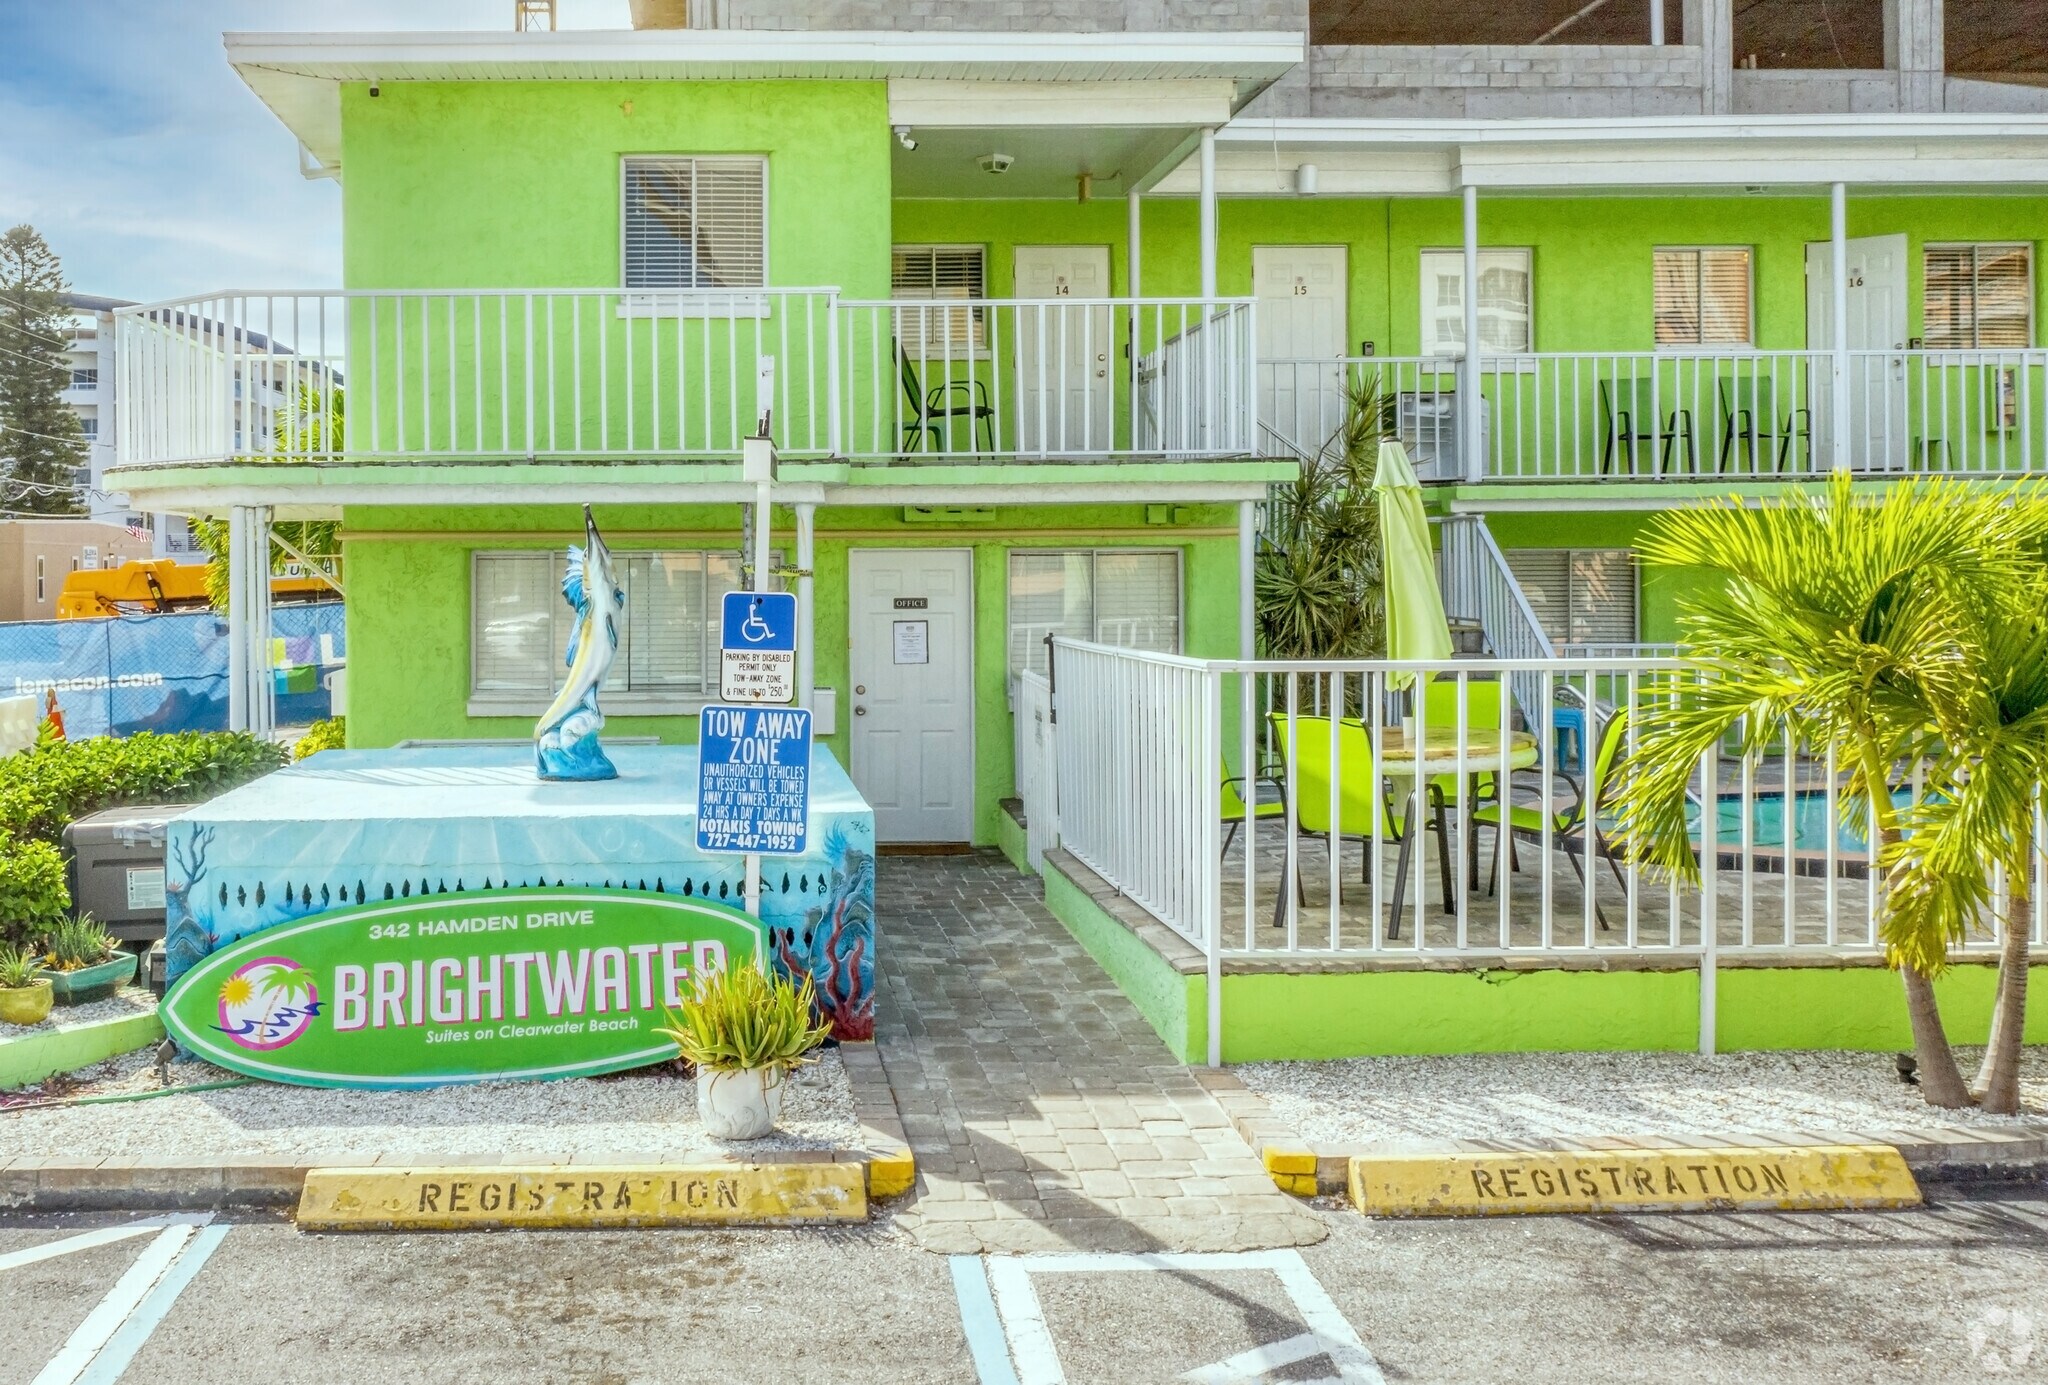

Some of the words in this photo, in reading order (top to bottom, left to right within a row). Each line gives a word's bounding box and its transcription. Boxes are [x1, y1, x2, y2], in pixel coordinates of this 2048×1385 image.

[1056, 286, 1069, 295] 14
[1294, 286, 1307, 295] 15
[1850, 277, 1863, 287] 16
[726, 653, 750, 661] PARKING
[762, 654, 790, 662] DISABLED
[739, 663, 759, 671] PERMIT
[734, 674, 763, 682] TOW-AWAY
[766, 675, 782, 683] ZONE
[726, 688, 730, 696] &
[733, 688, 746, 696] FINE
[707, 710, 746, 737] TOW
[755, 712, 806, 739] AWAY
[729, 737, 780, 765] ZONE
[704, 763, 763, 777] UNAUTHORIZED
[768, 766, 804, 780] VEHICLES
[703, 777, 713, 790] OR
[716, 778, 746, 791] VESSELS
[750, 779, 765, 793] WILL
[769, 780, 777, 793] BE
[781, 780, 804, 794] TOWED
[703, 791, 721, 804] AWAY
[725, 792, 733, 805] AT
[737, 792, 767, 806] OWNERS
[771, 794, 803, 808] EXPENSE
[703, 805, 712, 818] 24
[716, 806, 729, 819] HRS
[733, 806, 738, 819] A
[741, 806, 753, 820] DAY
[756, 807, 760, 820] 7
[763, 808, 780, 821] DAYS
[783, 808, 788, 821] A
[792, 808, 802, 821] WK
[700, 819, 750, 834] KOTAKIS
[757, 821, 804, 836] TOWING
[707, 833, 796, 850] 727-447-1952
[369, 923, 410, 939] 342
[418, 915, 518, 936] HAMDEN
[526, 910, 594, 929] DRIVE
[333, 940, 728, 1031] BRIGHTWATER
[426, 1030, 469, 1044] Suites
[474, 1026, 493, 1040] on
[499, 1021, 584, 1038] Clearwater
[589, 1017, 638, 1032] Beach
[1471, 1164, 1790, 1199] REGISTRATION
[418, 1180, 738, 1212] REGISTRAION
